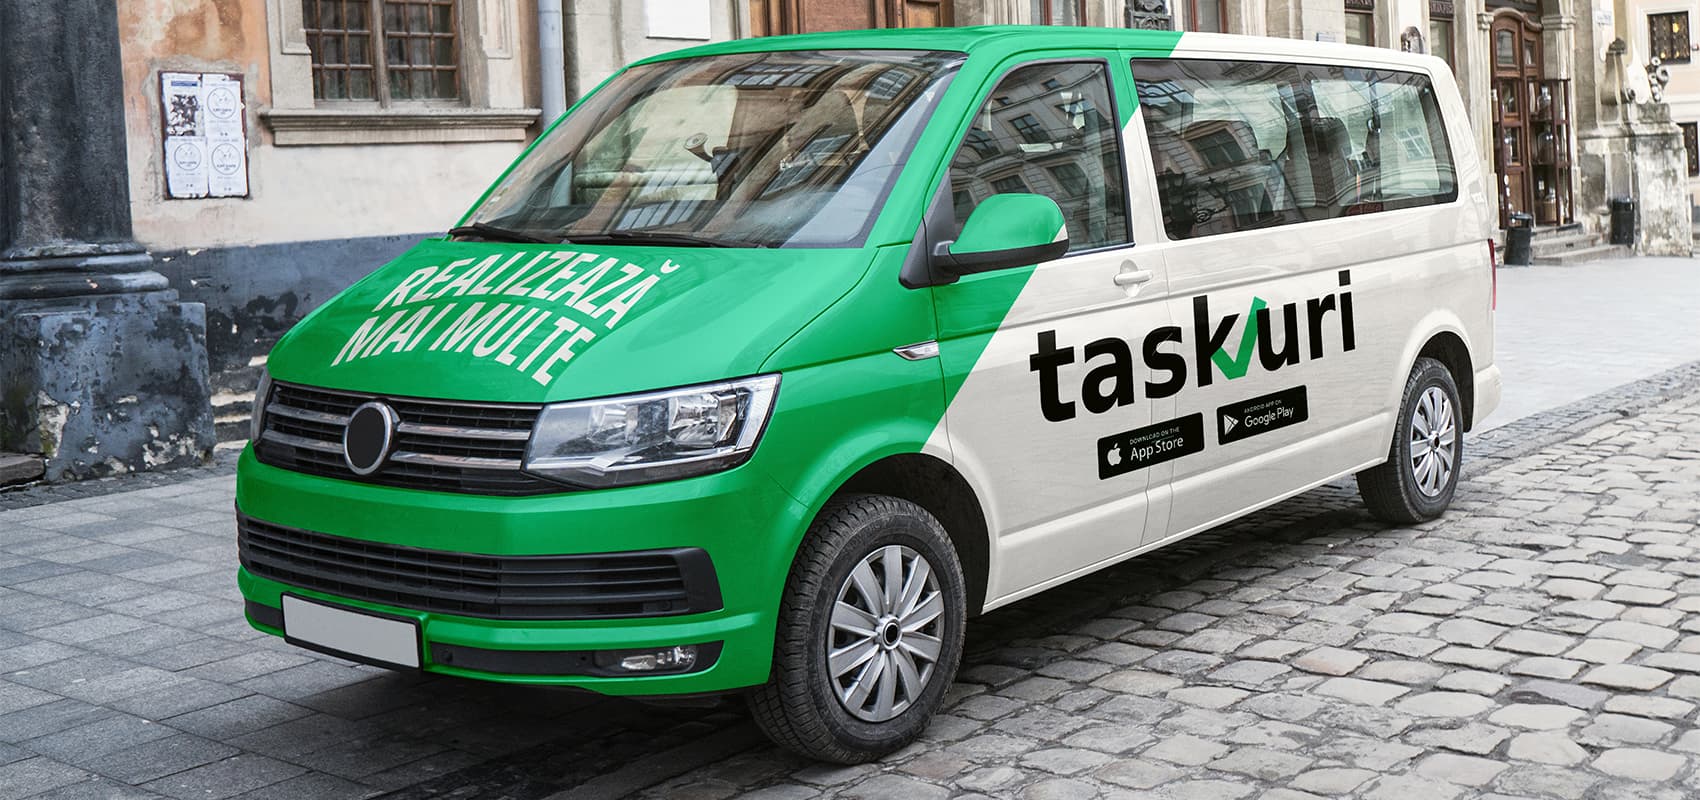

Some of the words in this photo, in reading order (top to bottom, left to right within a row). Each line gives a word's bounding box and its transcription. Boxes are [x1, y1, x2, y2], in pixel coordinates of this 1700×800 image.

[372, 250, 681, 330] REALIZEAZĂ
[330, 302, 458, 368] MAI
[428, 301, 597, 387] MULTE
[1029, 269, 1356, 423] taskuri
[1129, 432, 1161, 445] DOWNLOAD
[1169, 426, 1180, 434] THE
[1244, 410, 1276, 428] Google
[1277, 406, 1294, 419] Play
[1130, 446, 1154, 462] App
[1155, 437, 1184, 454] Store
